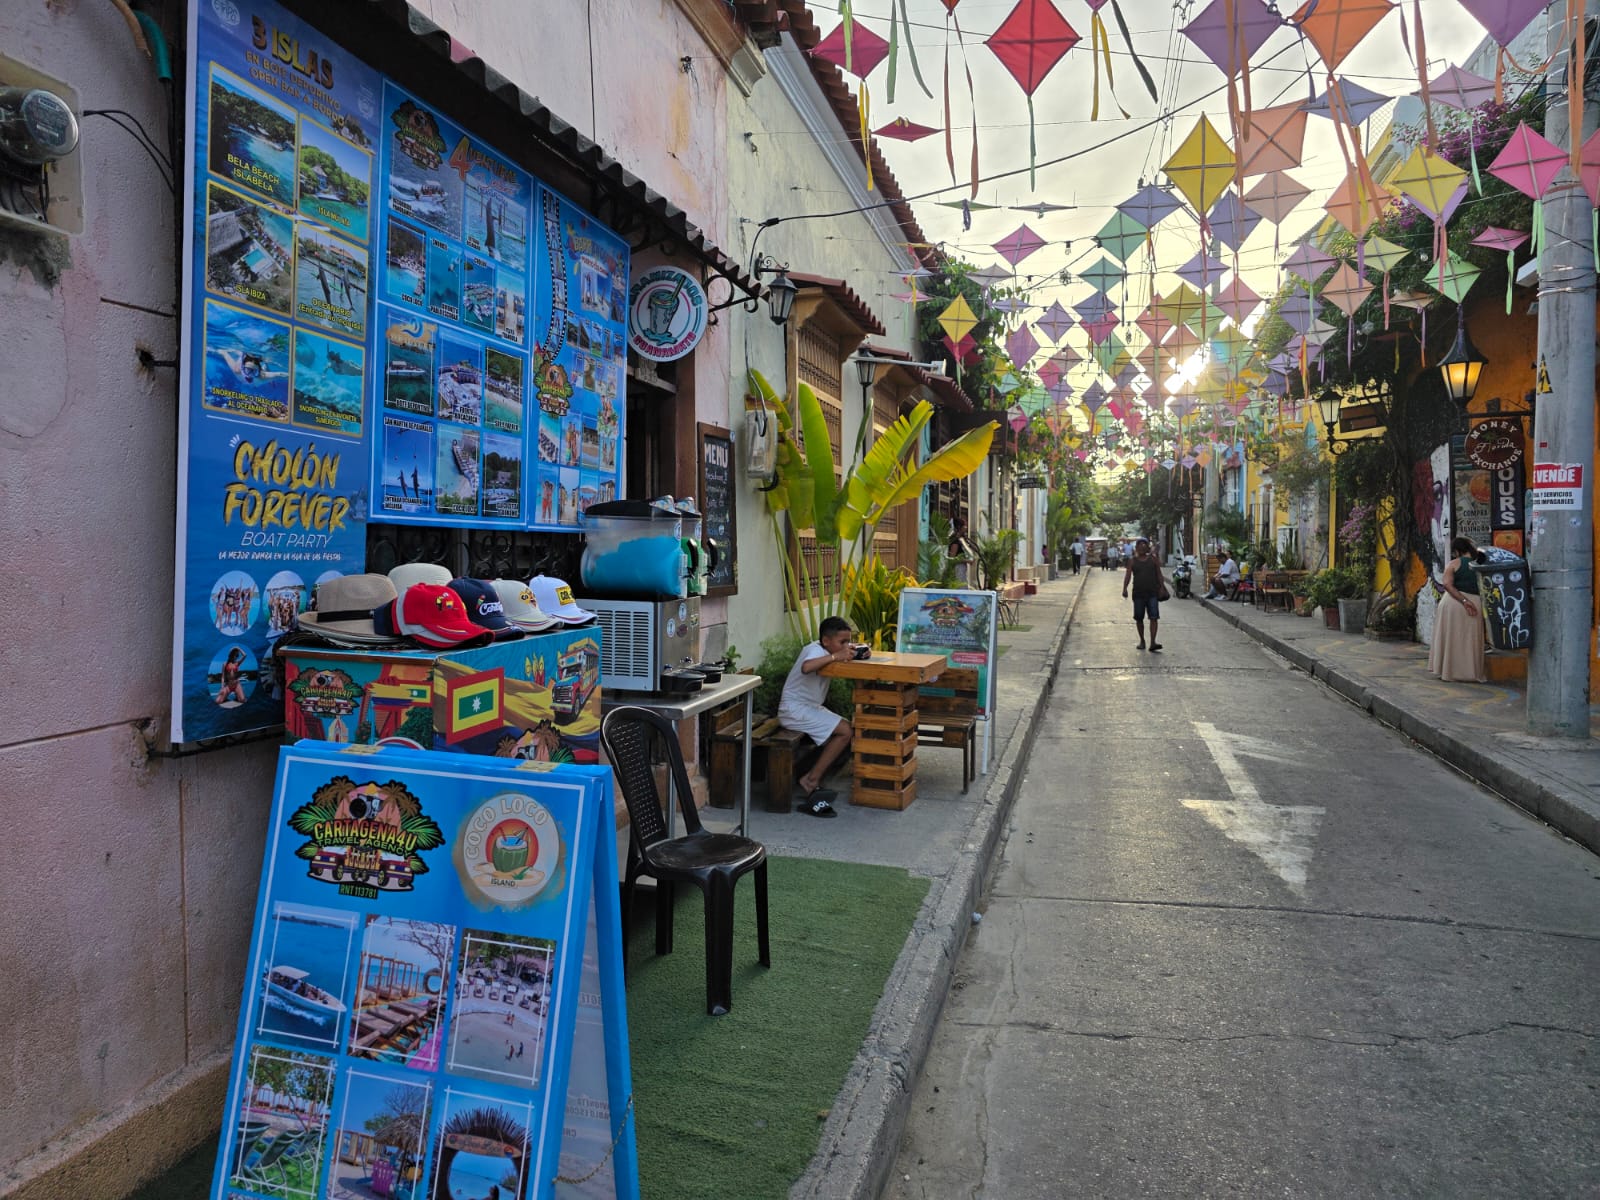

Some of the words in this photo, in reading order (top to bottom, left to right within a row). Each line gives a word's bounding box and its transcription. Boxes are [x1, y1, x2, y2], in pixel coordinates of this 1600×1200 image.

[252, 14, 266, 50] 3
[271, 27, 334, 89] ISLAS
[250, 67, 278, 88] OPEN
[227, 153, 250, 171] BELA
[251, 164, 280, 185] BEACH
[233, 168, 274, 193] ISLABELA
[236, 284, 250, 297] ISLA
[250, 288, 266, 302] IBIZA
[1471, 421, 1518, 440] MONEY
[234, 438, 341, 491] CHOLÓN
[1469, 449, 1522, 470] EXCHANGE
[1537, 469, 1575, 483] VENDE
[223, 482, 350, 534] FOREVER
[1498, 469, 1515, 526] OURS
[241, 531, 286, 547] BOAT
[287, 534, 333, 548] PARTY
[219, 552, 226, 560] LA
[228, 551, 250, 560] MEJOR
[274, 552, 282, 560] EN
[283, 552, 291, 560] LA
[314, 819, 417, 852] CARTAGENA4U
[465, 807, 496, 861] COCO
[500, 797, 549, 827] LOCO
[317, 837, 359, 847] TRAVEL
[365, 839, 412, 859] AGENCY
[340, 885, 354, 896] RNT
[355, 886, 377, 899] 113781
[490, 878, 515, 887] ISLAND
